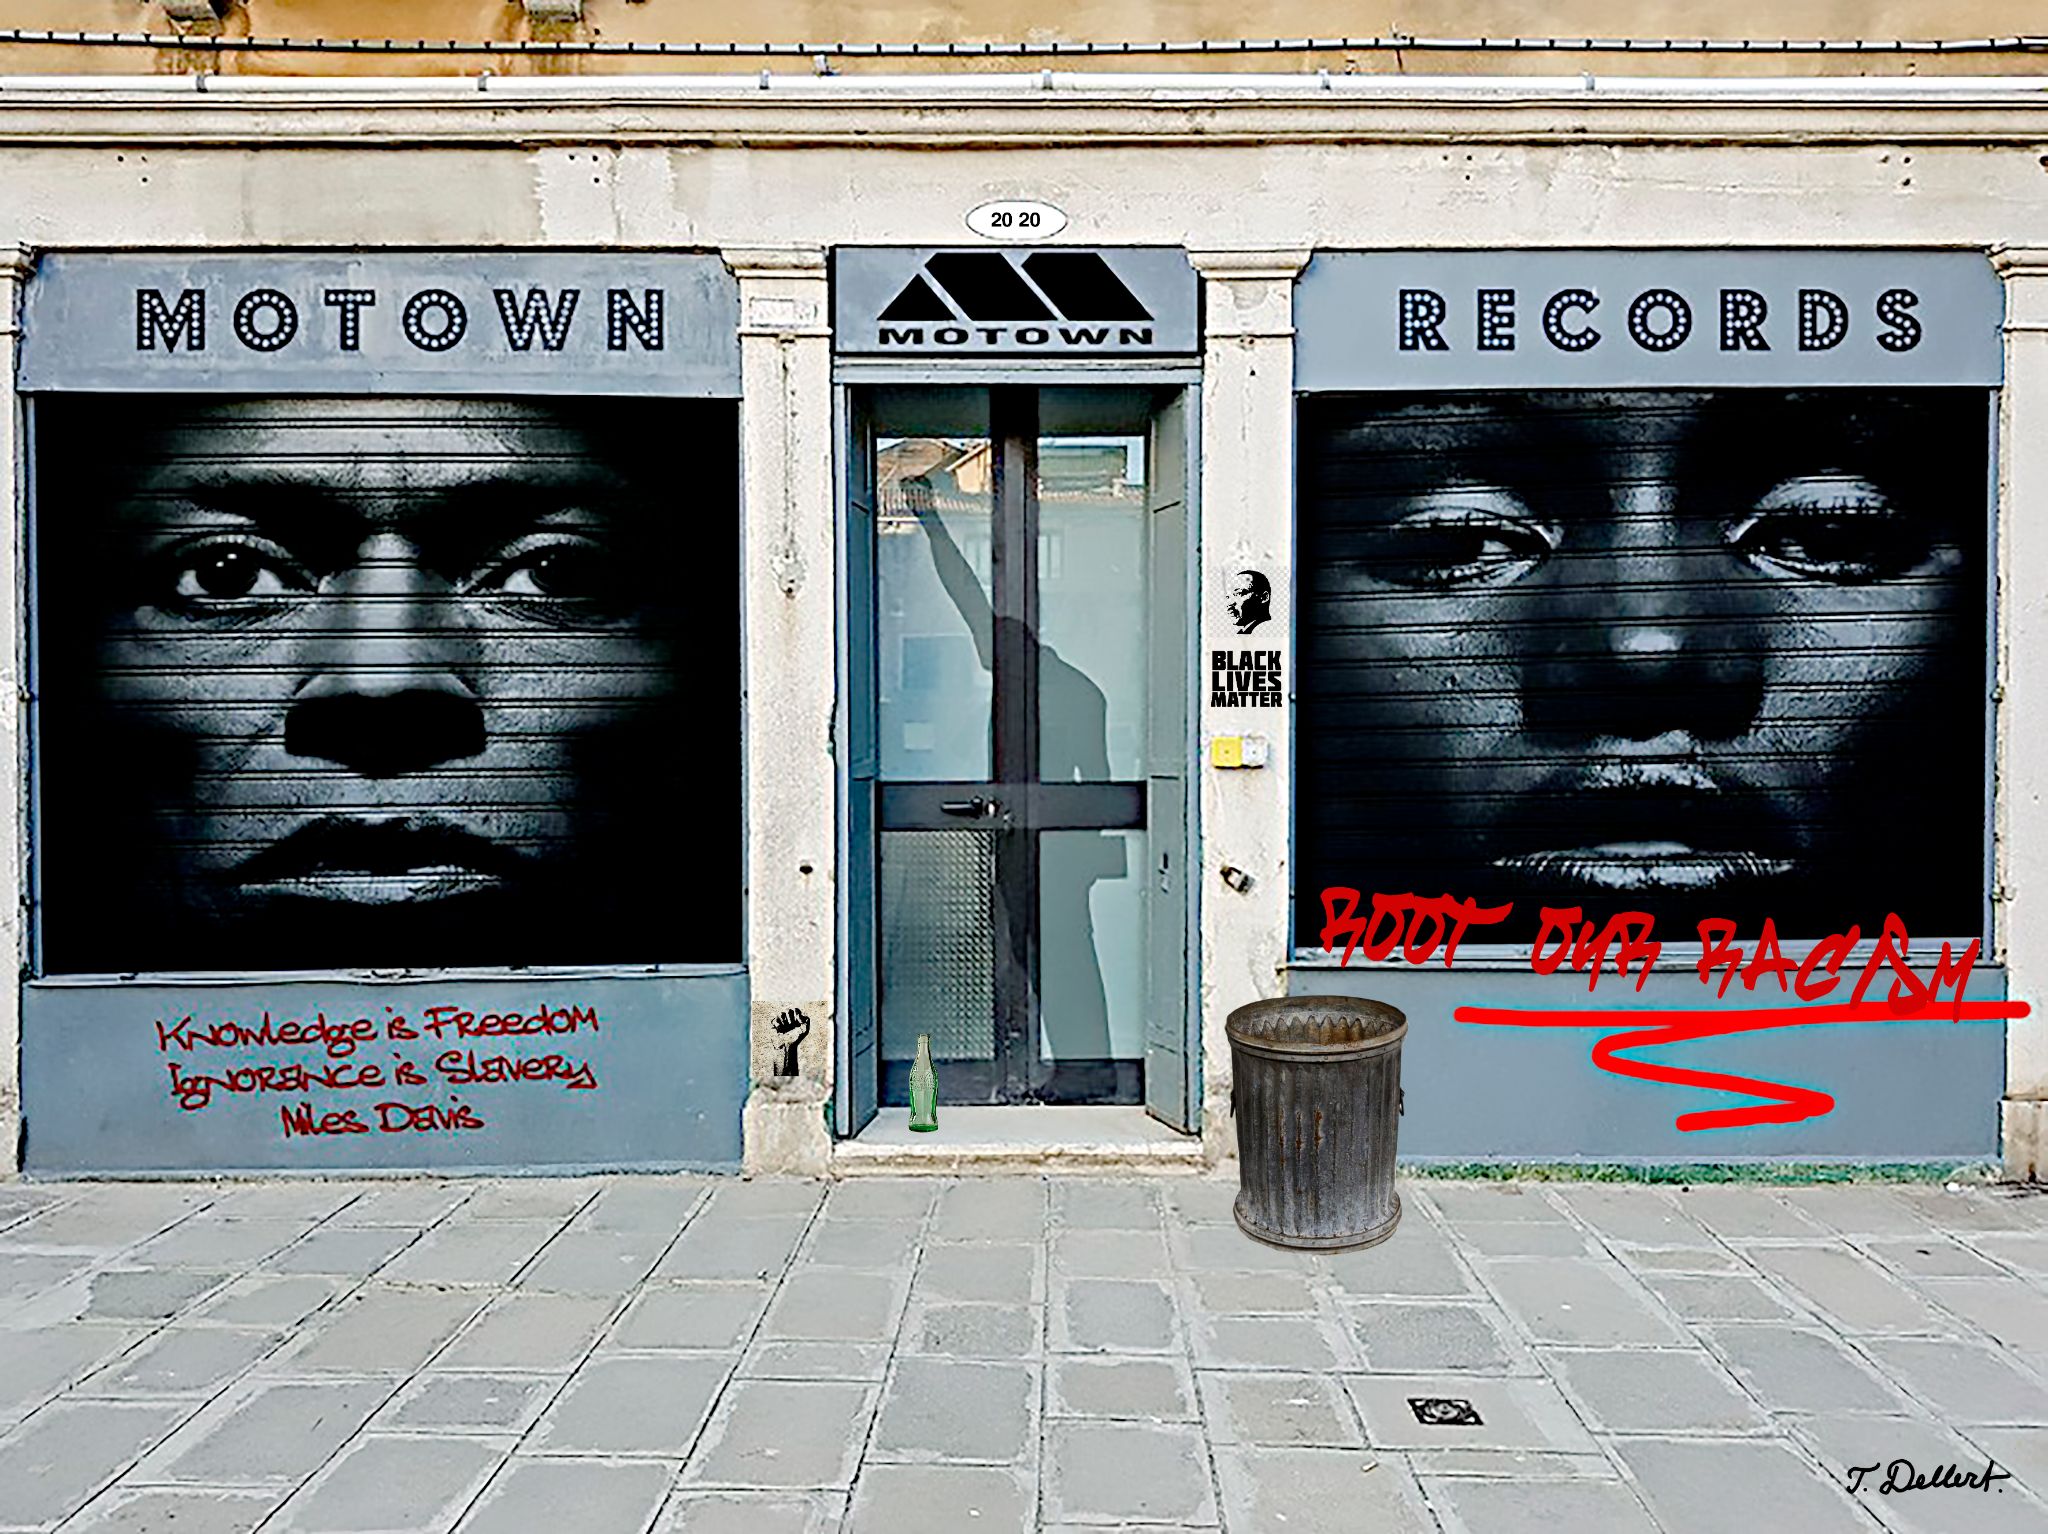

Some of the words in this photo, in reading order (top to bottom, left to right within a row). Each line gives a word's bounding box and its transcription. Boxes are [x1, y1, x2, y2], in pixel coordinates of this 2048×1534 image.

[990, 211, 1013, 228] 20
[1018, 211, 1041, 228] 20
[136, 287, 664, 353] MOTOWN
[1399, 288, 1922, 353] RECORDS
[878, 327, 1153, 345] MOTOWN
[1211, 650, 1282, 671] BLACK
[1211, 671, 1282, 692] LIVES
[1210, 692, 1283, 708] MATTER
[1319, 886, 1513, 968] ROOT
[1696, 912, 1981, 1023] RACISM
[385, 1006, 419, 1039] is
[393, 1052, 428, 1086] is
